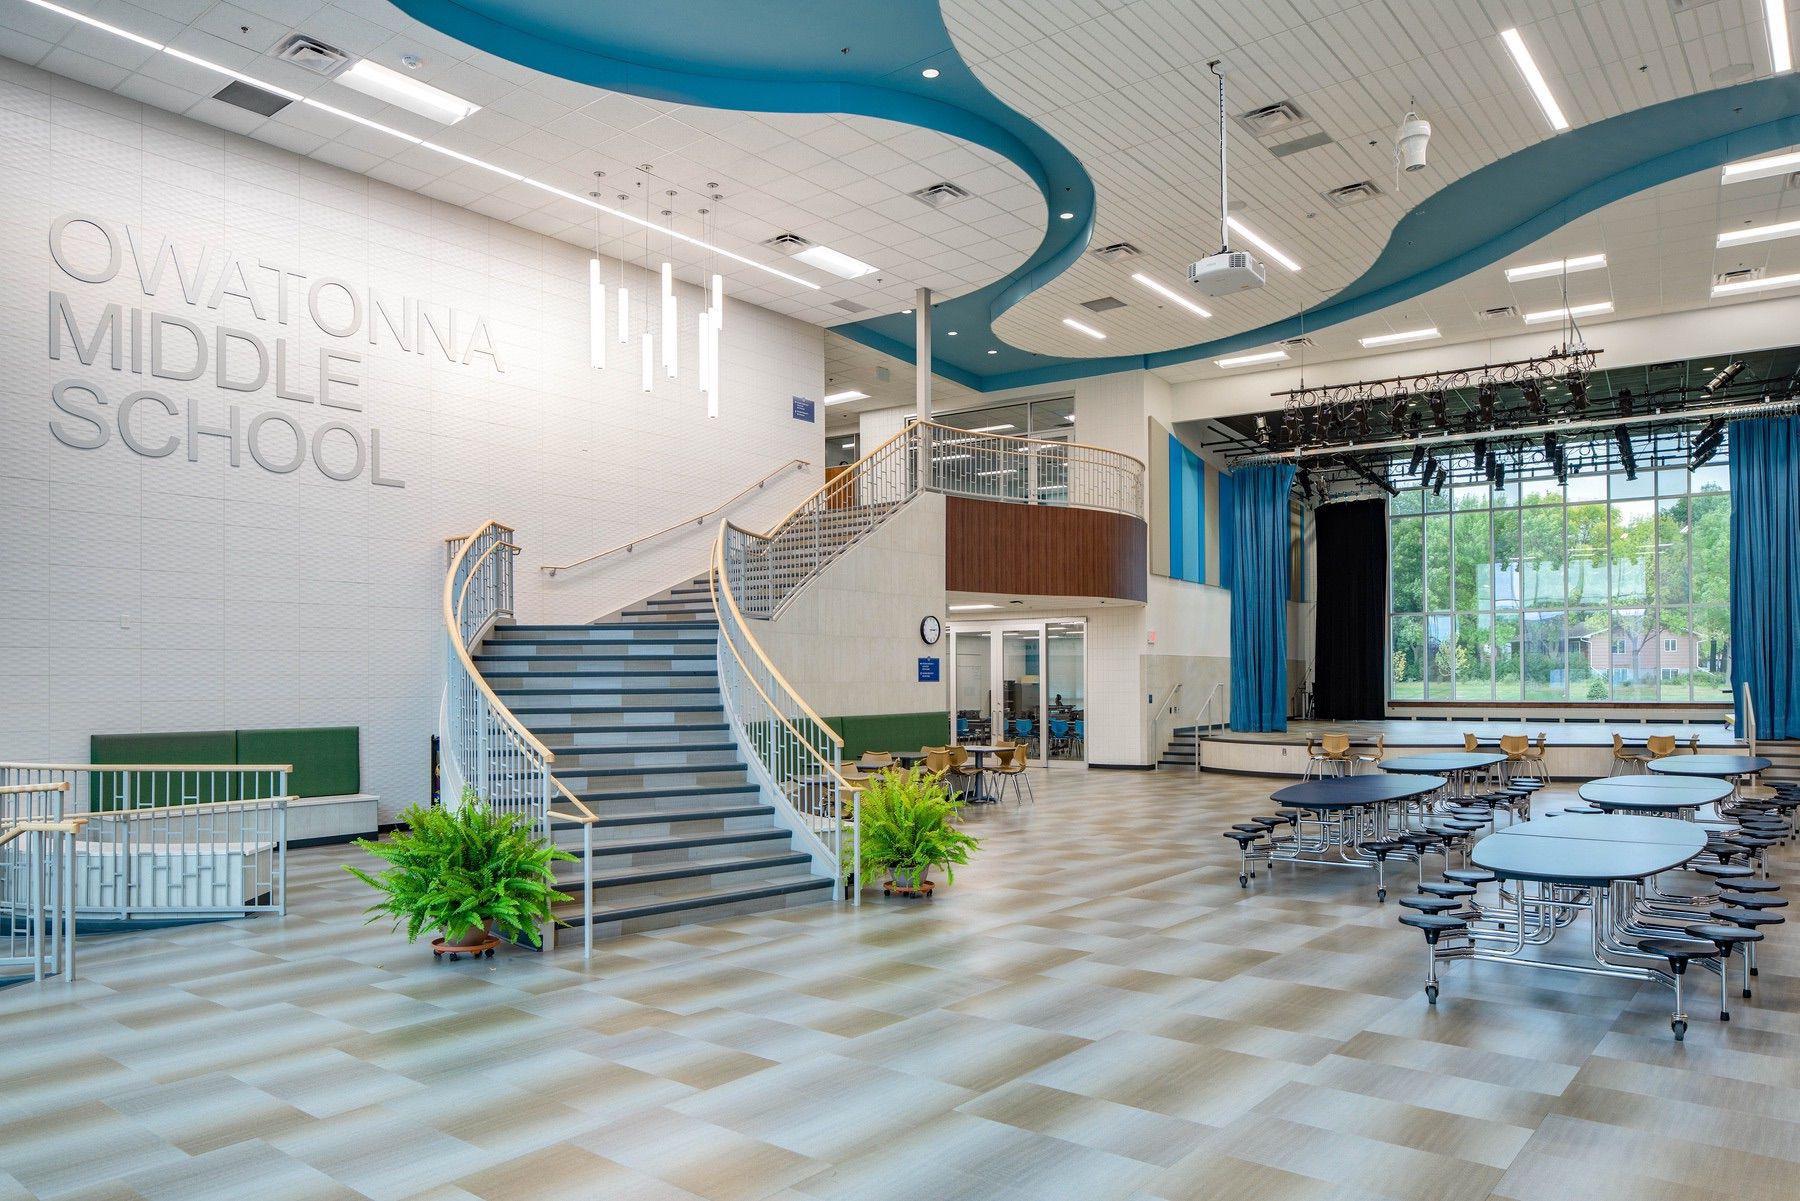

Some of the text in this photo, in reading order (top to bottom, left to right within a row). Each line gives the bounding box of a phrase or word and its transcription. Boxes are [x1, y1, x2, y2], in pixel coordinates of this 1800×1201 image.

[48, 211, 506, 374] OWATONNA
[48, 290, 363, 413] MIDDLE
[48, 378, 406, 489] SCHOOL
